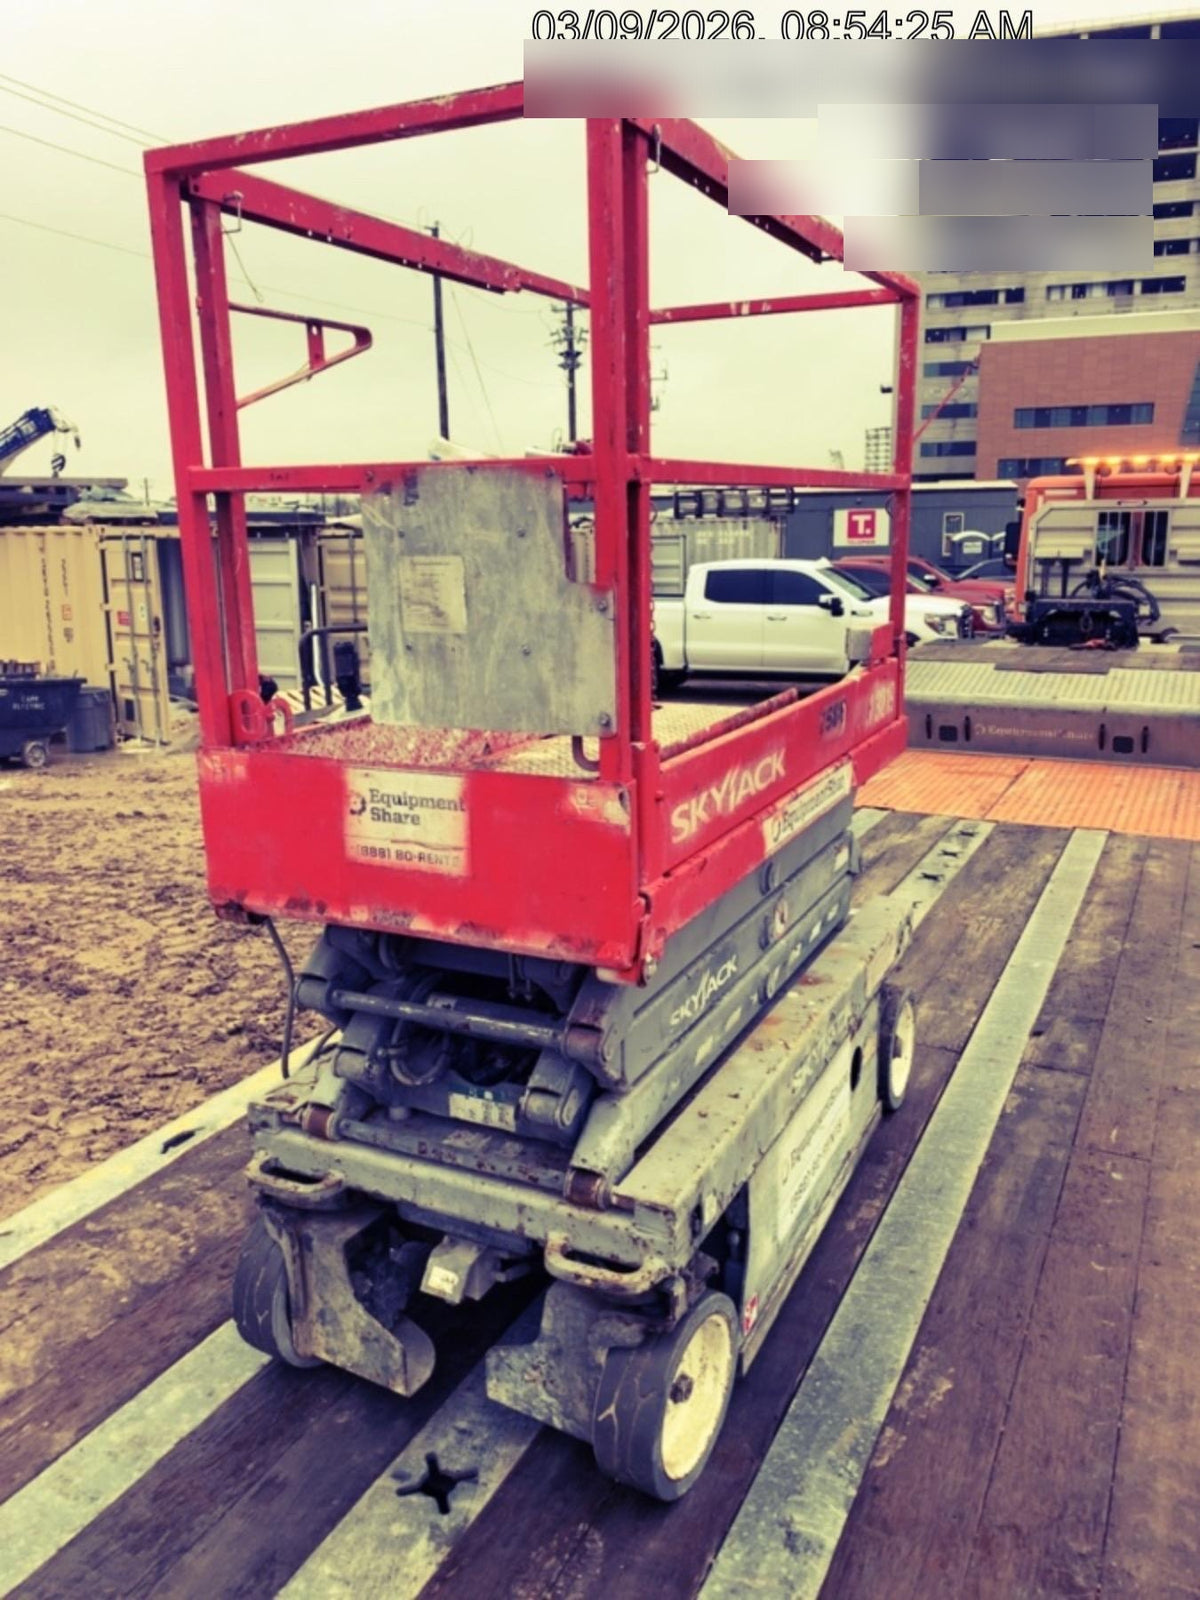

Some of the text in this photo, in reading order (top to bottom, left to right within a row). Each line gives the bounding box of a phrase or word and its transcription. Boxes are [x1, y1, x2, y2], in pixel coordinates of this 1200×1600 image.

[369, 788, 466, 812] Equipment
[370, 806, 421, 826] Share
[670, 746, 786, 845] SKYJACK
[669, 954, 740, 1026] SKYJACK
